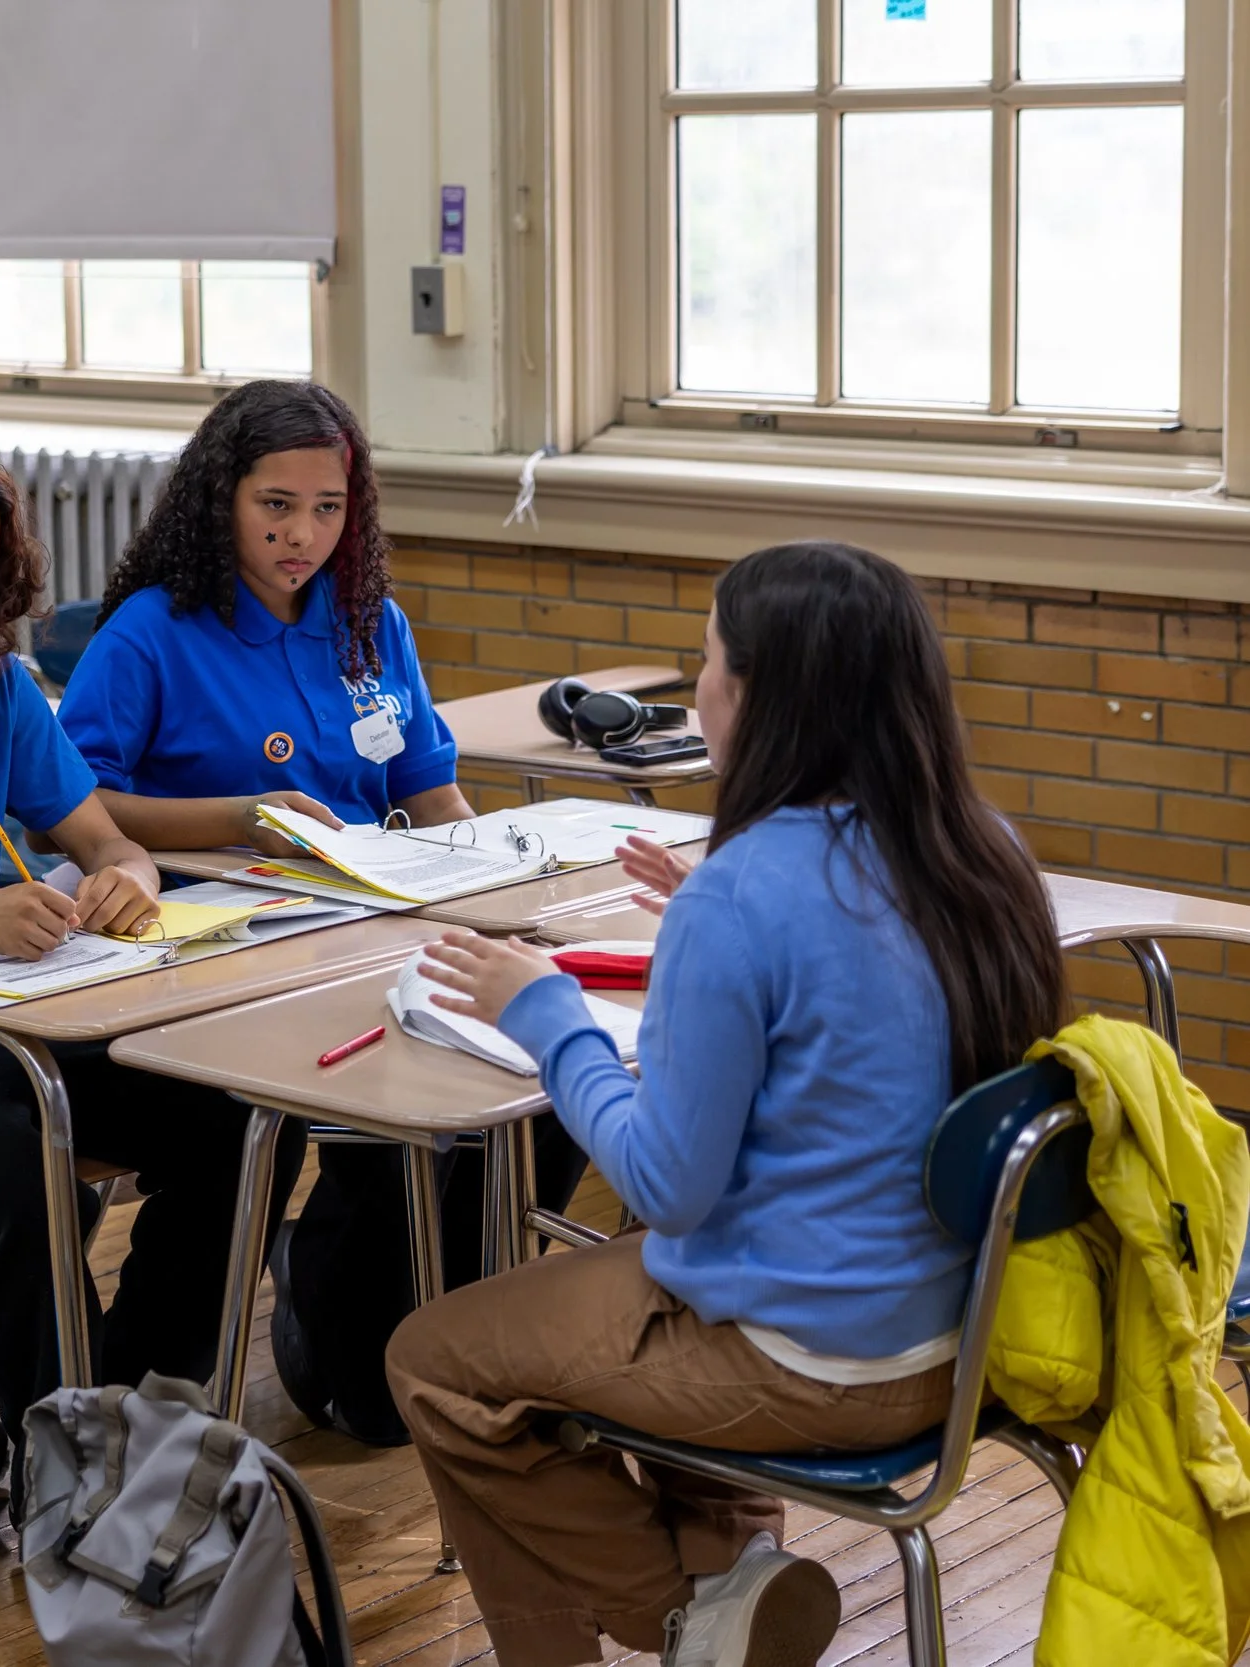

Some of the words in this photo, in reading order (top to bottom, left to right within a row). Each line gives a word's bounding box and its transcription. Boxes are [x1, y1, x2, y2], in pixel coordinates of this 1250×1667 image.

[339, 672, 381, 695] MS
[375, 694, 401, 715] 50
[274, 739, 287, 749] MS
